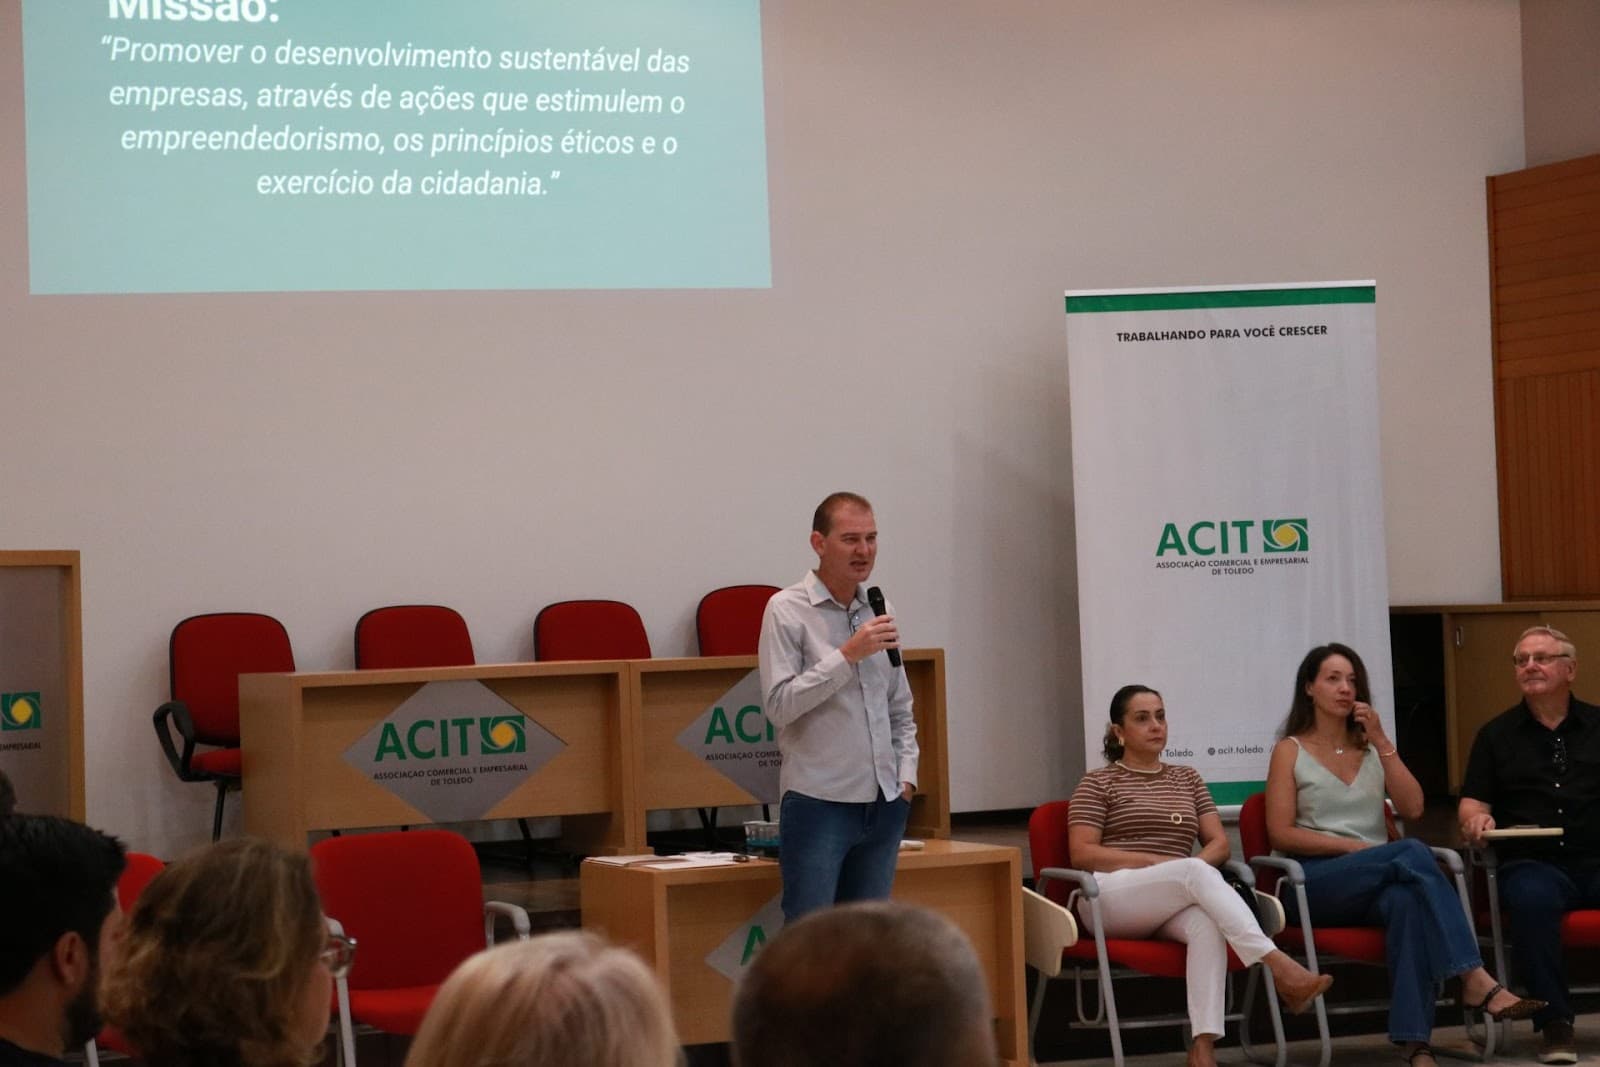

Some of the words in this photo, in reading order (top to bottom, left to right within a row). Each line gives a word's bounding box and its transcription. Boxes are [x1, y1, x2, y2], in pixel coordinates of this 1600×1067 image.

[250, 45, 266, 64] o
[275, 39, 492, 68] desenvolvimento
[499, 47, 640, 72] sustentável
[647, 48, 690, 73] das
[109, 85, 248, 111] empresas,
[256, 83, 352, 108] através
[361, 84, 391, 109] de
[399, 85, 474, 115] ações
[482, 91, 528, 116] que
[535, 88, 662, 113] estimulem
[670, 95, 686, 113] o
[121, 124, 385, 155] empreendedorismo,
[393, 132, 424, 151] os
[430, 127, 553, 158] princípios
[561, 129, 634, 154] éticos
[642, 137, 655, 154] e
[663, 137, 677, 154] o
[256, 168, 374, 194] exercício
[381, 169, 412, 195] da
[1117, 330, 1206, 342] TRABALHANDO
[1210, 328, 1240, 339] PARA
[1244, 325, 1275, 337] VOCÊ
[1279, 325, 1328, 336] CRESCER
[1156, 520, 1254, 556] ACIT
[1208, 559, 1251, 567] COMERCIAL
[1260, 557, 1309, 565] EMPRESARIAL
[1224, 567, 1254, 575] TOLEDO
[704, 705, 774, 745] ACI
[374, 718, 475, 762] ACIT
[1217, 745, 1264, 755] acit.toledo
[1165, 748, 1194, 758] Toledo
[427, 767, 471, 777] COMERCIAL
[479, 764, 528, 774] EMPRESARIAL
[443, 777, 473, 785] TOLEDO
